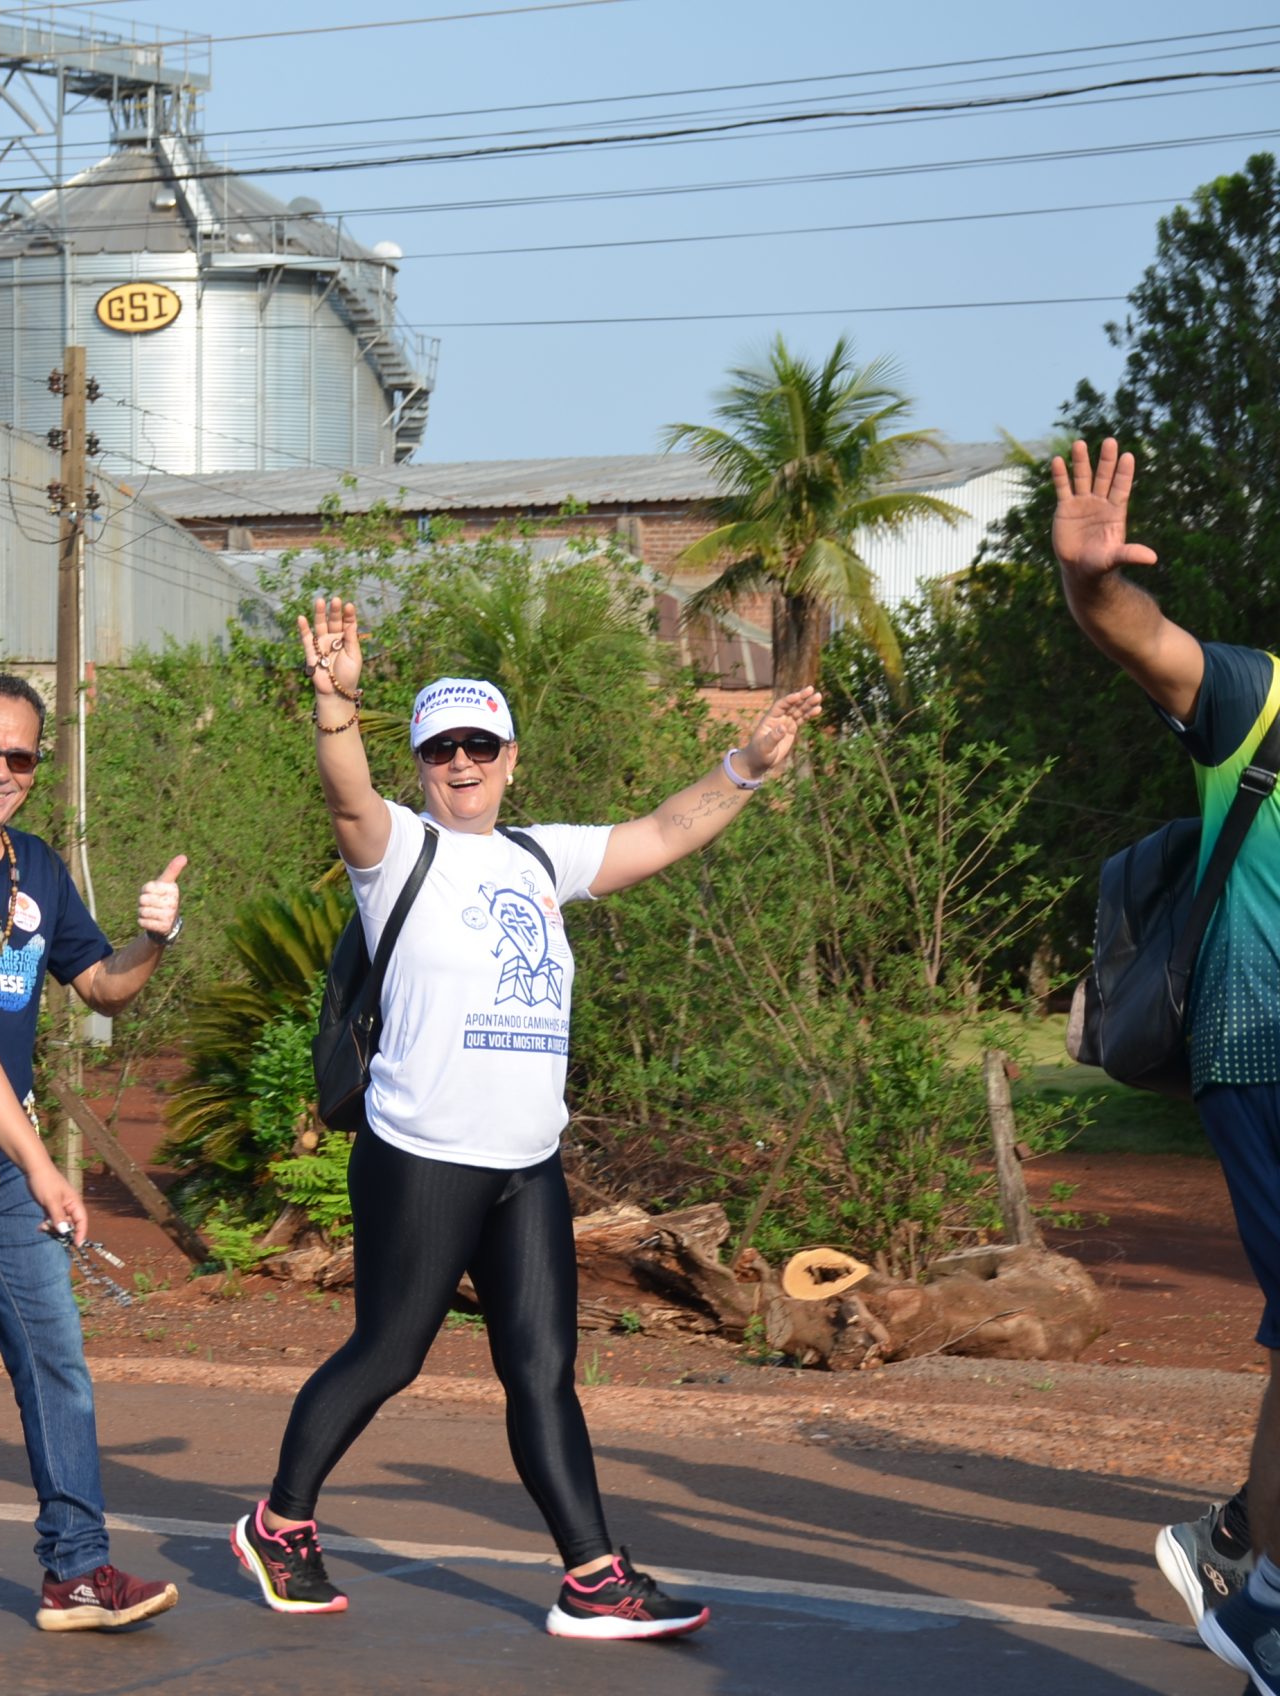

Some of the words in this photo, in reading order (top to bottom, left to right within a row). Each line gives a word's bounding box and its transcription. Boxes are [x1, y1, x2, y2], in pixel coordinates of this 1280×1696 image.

[454, 696, 481, 705] VIDA
[464, 1013, 522, 1028] APONTANDO
[466, 1032, 487, 1048] QUE
[488, 1031, 512, 1049] VOCÊ
[513, 1034, 546, 1051] MOSTRE
[107, 1291, 169, 1323] GSI
